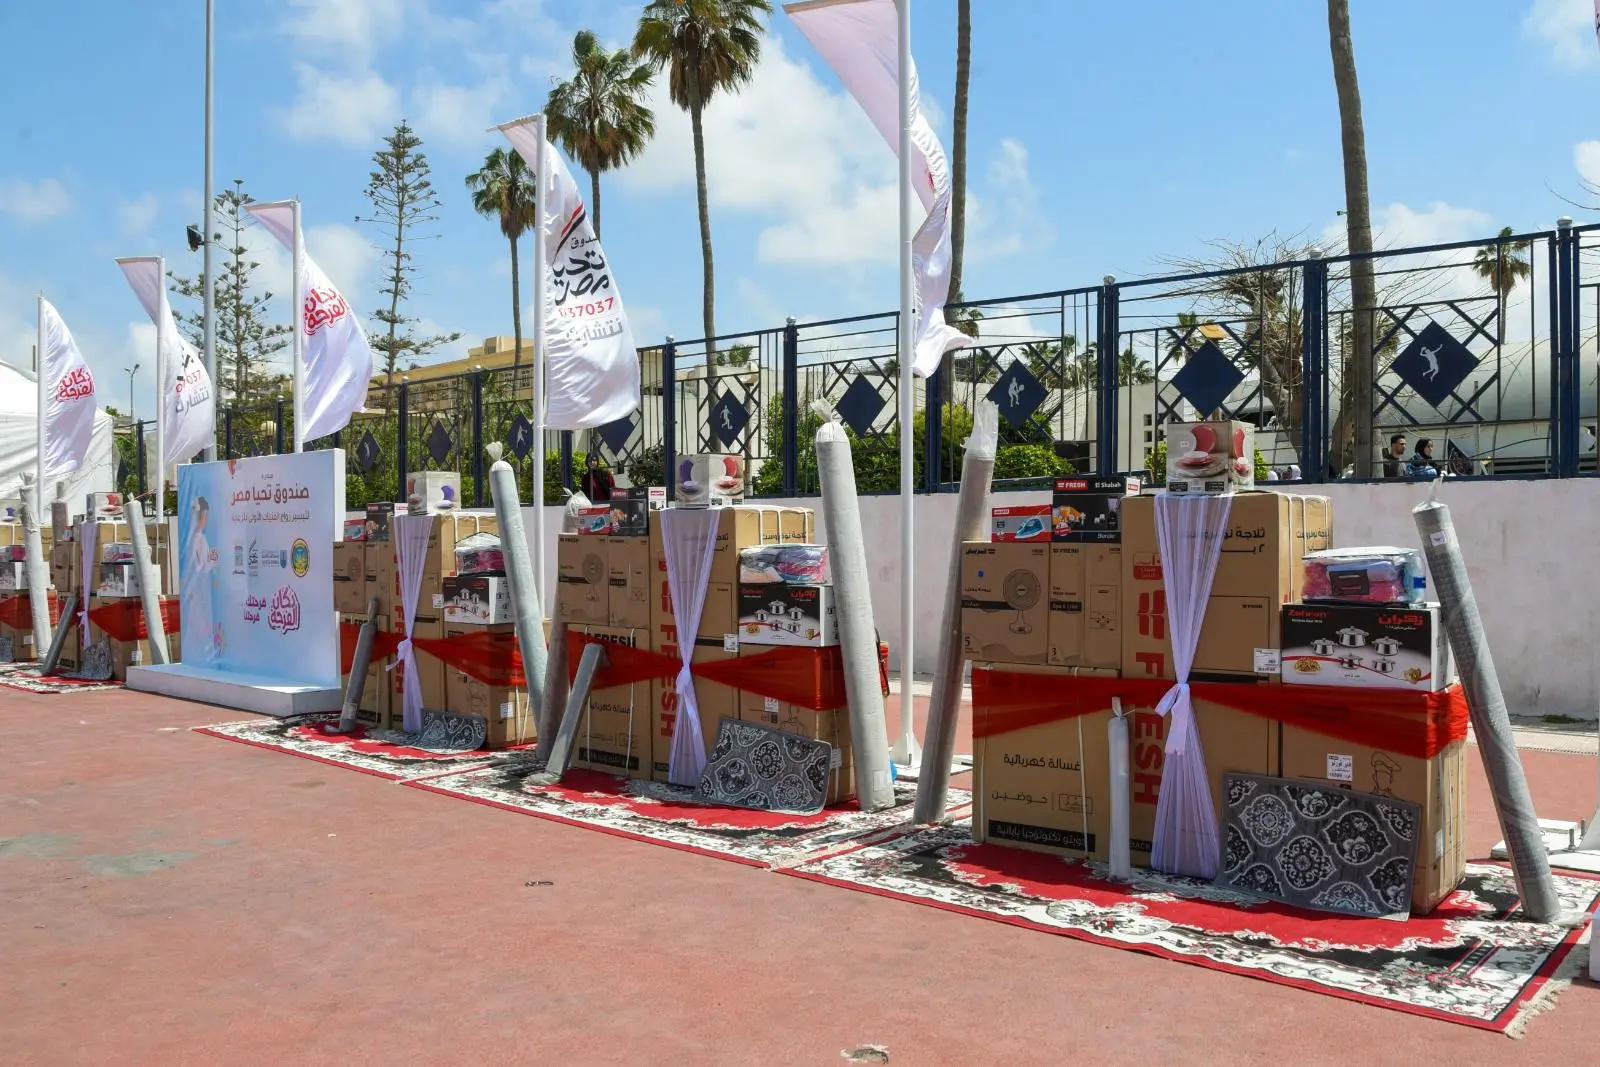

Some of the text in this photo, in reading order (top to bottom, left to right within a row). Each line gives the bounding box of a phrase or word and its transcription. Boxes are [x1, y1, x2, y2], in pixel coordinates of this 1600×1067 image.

[231, 482, 310, 506] صندوق تحيا مصر
[1236, 526, 1266, 540] ثلاجة
[272, 585, 296, 610] دكان
[270, 605, 298, 630] الفرحة
[1133, 652, 1165, 804] FESH
[1003, 753, 1082, 771] غسالة كهربائية
[991, 791, 1048, 804] حوضين
[1022, 826, 1062, 842] تكنولوجيا
